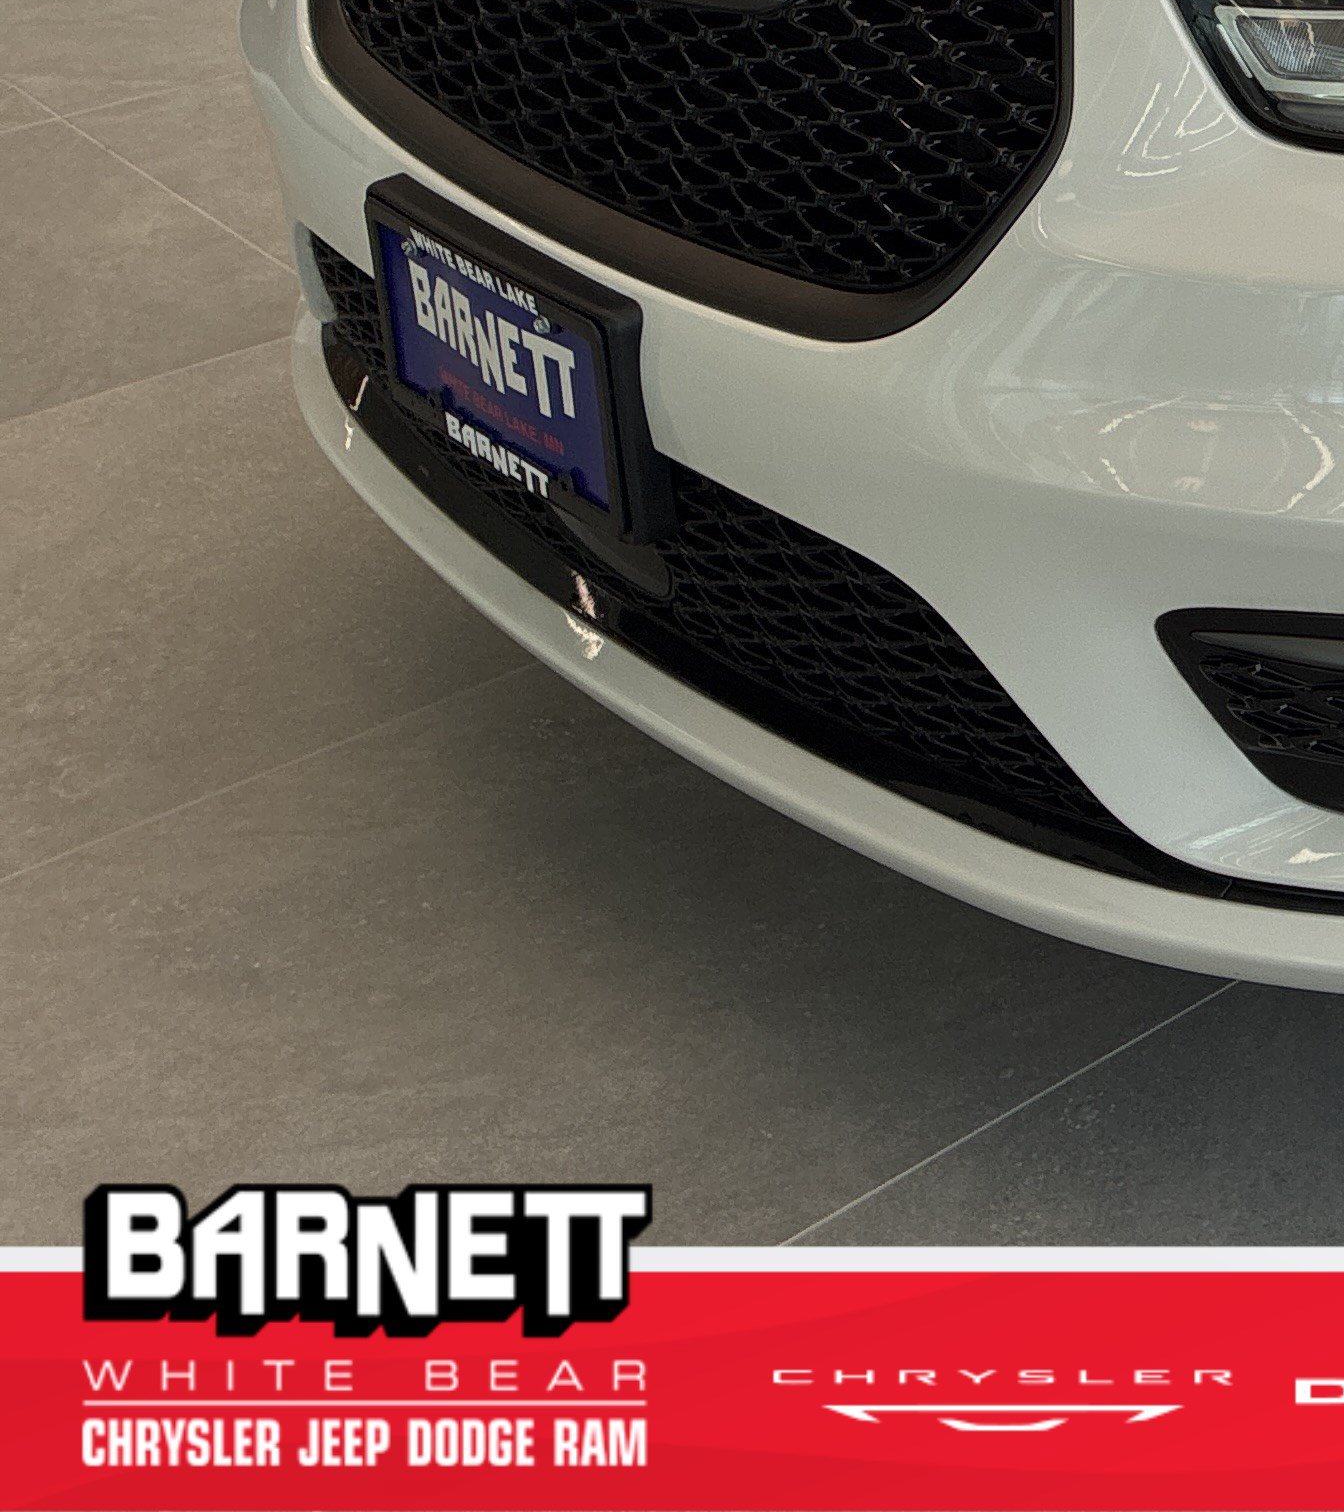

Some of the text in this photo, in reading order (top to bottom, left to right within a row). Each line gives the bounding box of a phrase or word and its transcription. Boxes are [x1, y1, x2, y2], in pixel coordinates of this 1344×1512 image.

[408, 226, 540, 317] WHITE BEAR LAKE
[406, 257, 577, 420] BARNETT
[444, 410, 550, 500] BARNETT
